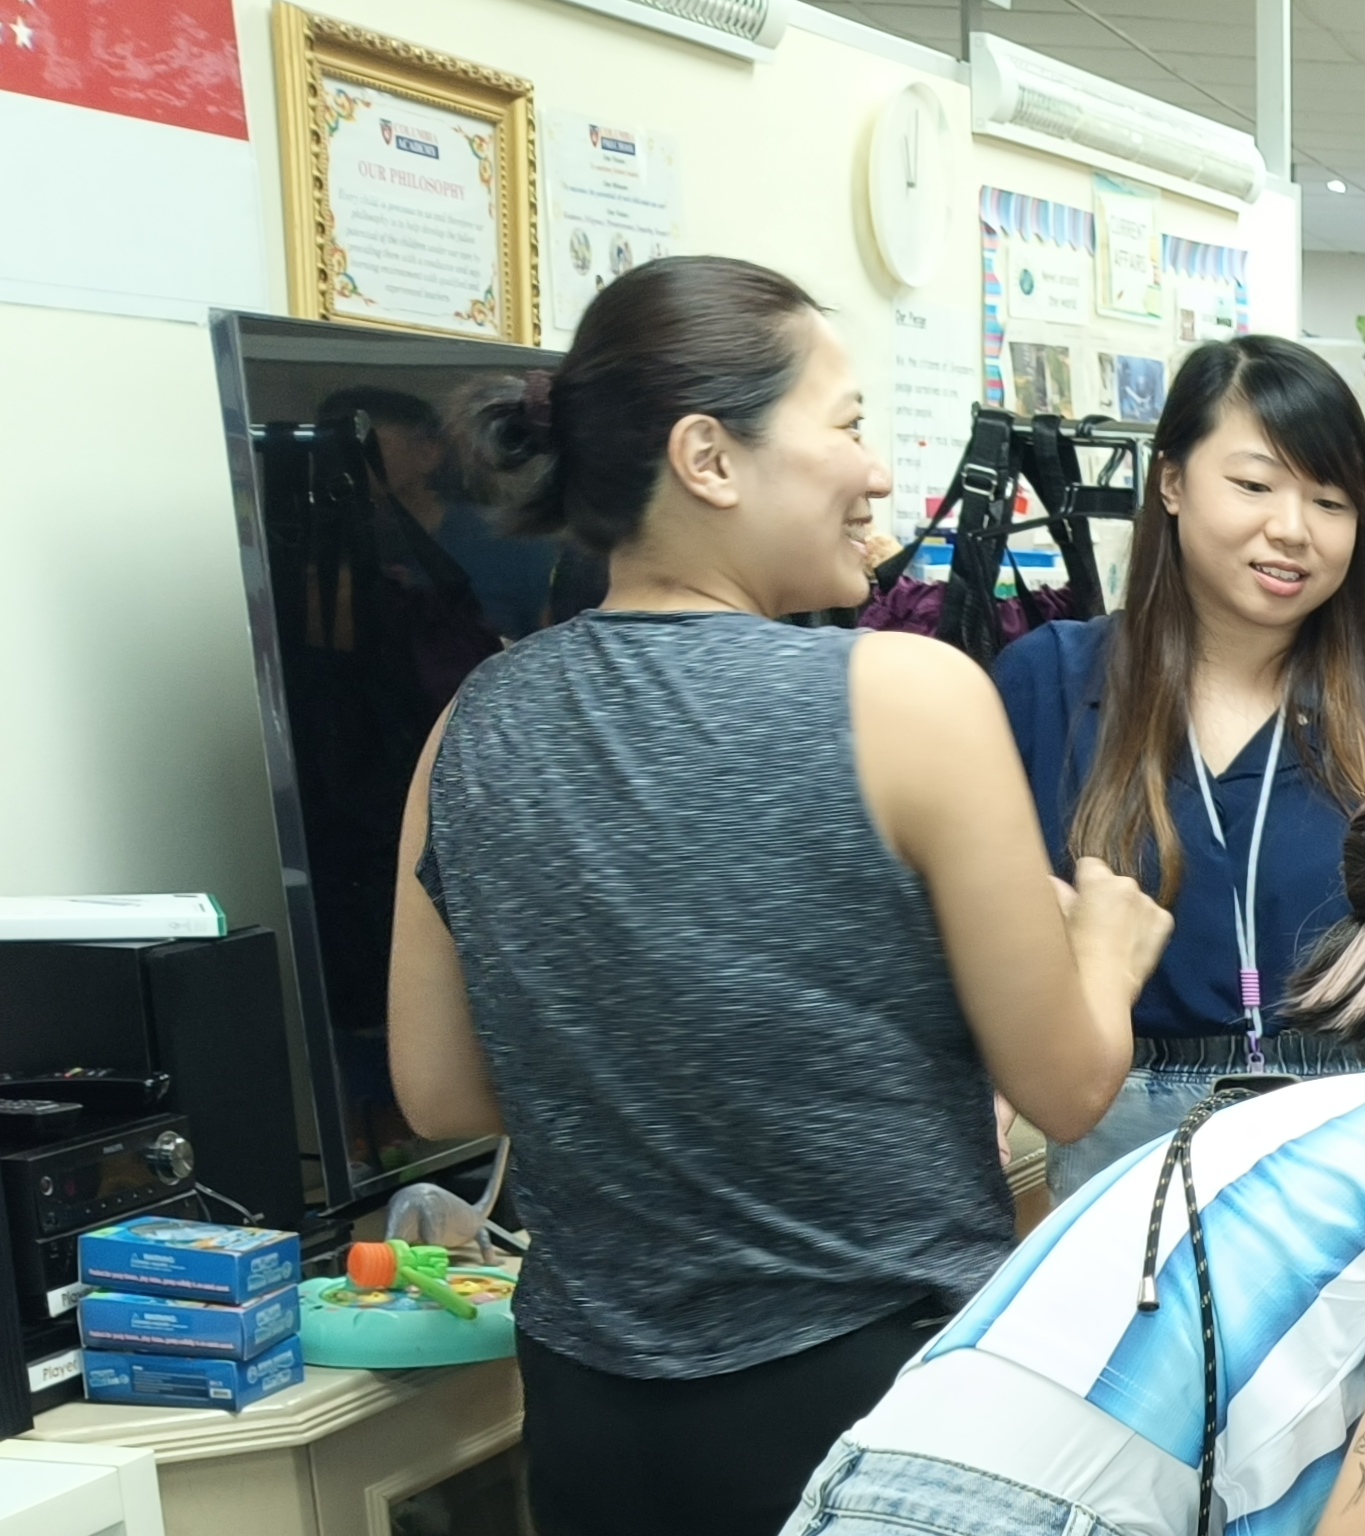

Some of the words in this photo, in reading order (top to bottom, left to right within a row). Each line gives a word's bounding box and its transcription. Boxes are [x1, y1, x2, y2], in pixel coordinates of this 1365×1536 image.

[358, 160, 386, 182] OUR
[389, 167, 465, 201] PHILOSOPHY
[1110, 214, 1147, 240] CURRENT
[1114, 249, 1147, 274] AFFAIRS
[42, 1358, 78, 1382] Player
